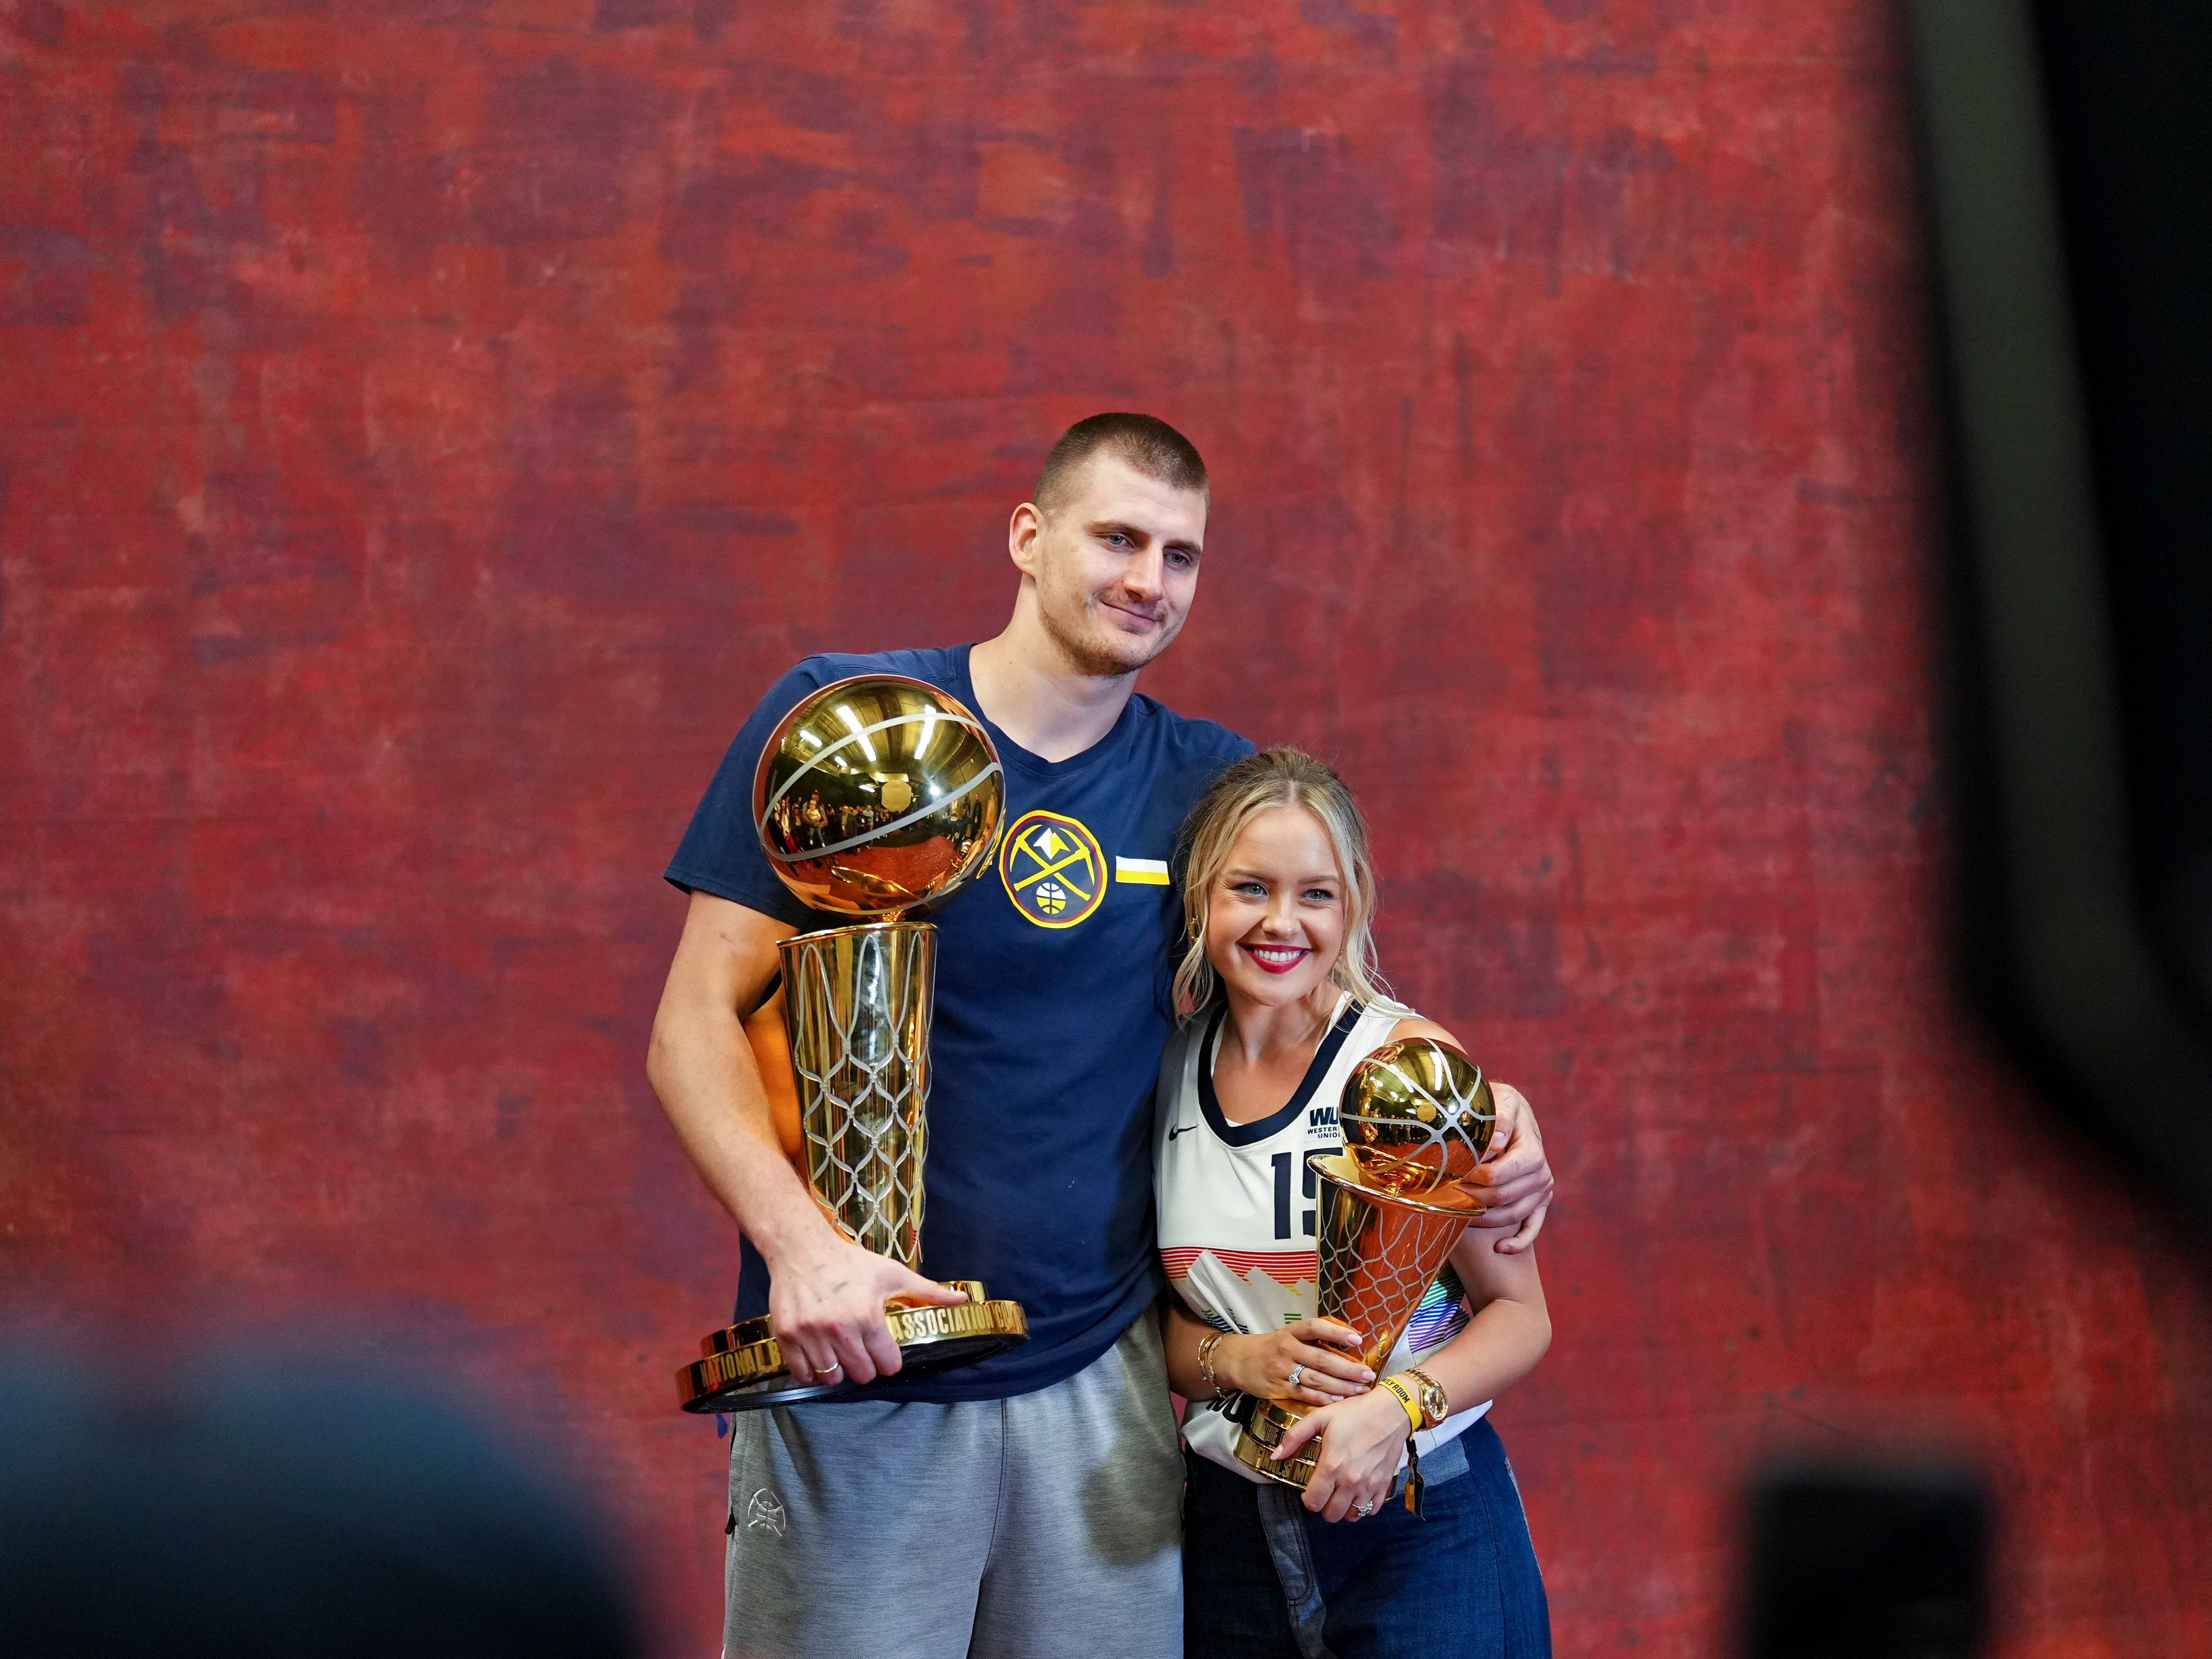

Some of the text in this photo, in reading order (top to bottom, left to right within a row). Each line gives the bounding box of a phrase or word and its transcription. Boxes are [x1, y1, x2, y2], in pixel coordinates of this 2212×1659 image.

[1310, 1107, 1338, 1127] WU
[1307, 1125, 1339, 1134] WESTER
[699, 1344, 766, 1387] NATIONAL
[891, 1305, 994, 1341] ASSOCIATION
[1392, 1384, 1410, 1403] ROOM
[1264, 1423, 1279, 1445] THE
[1255, 1446, 1292, 1477] FINALS
